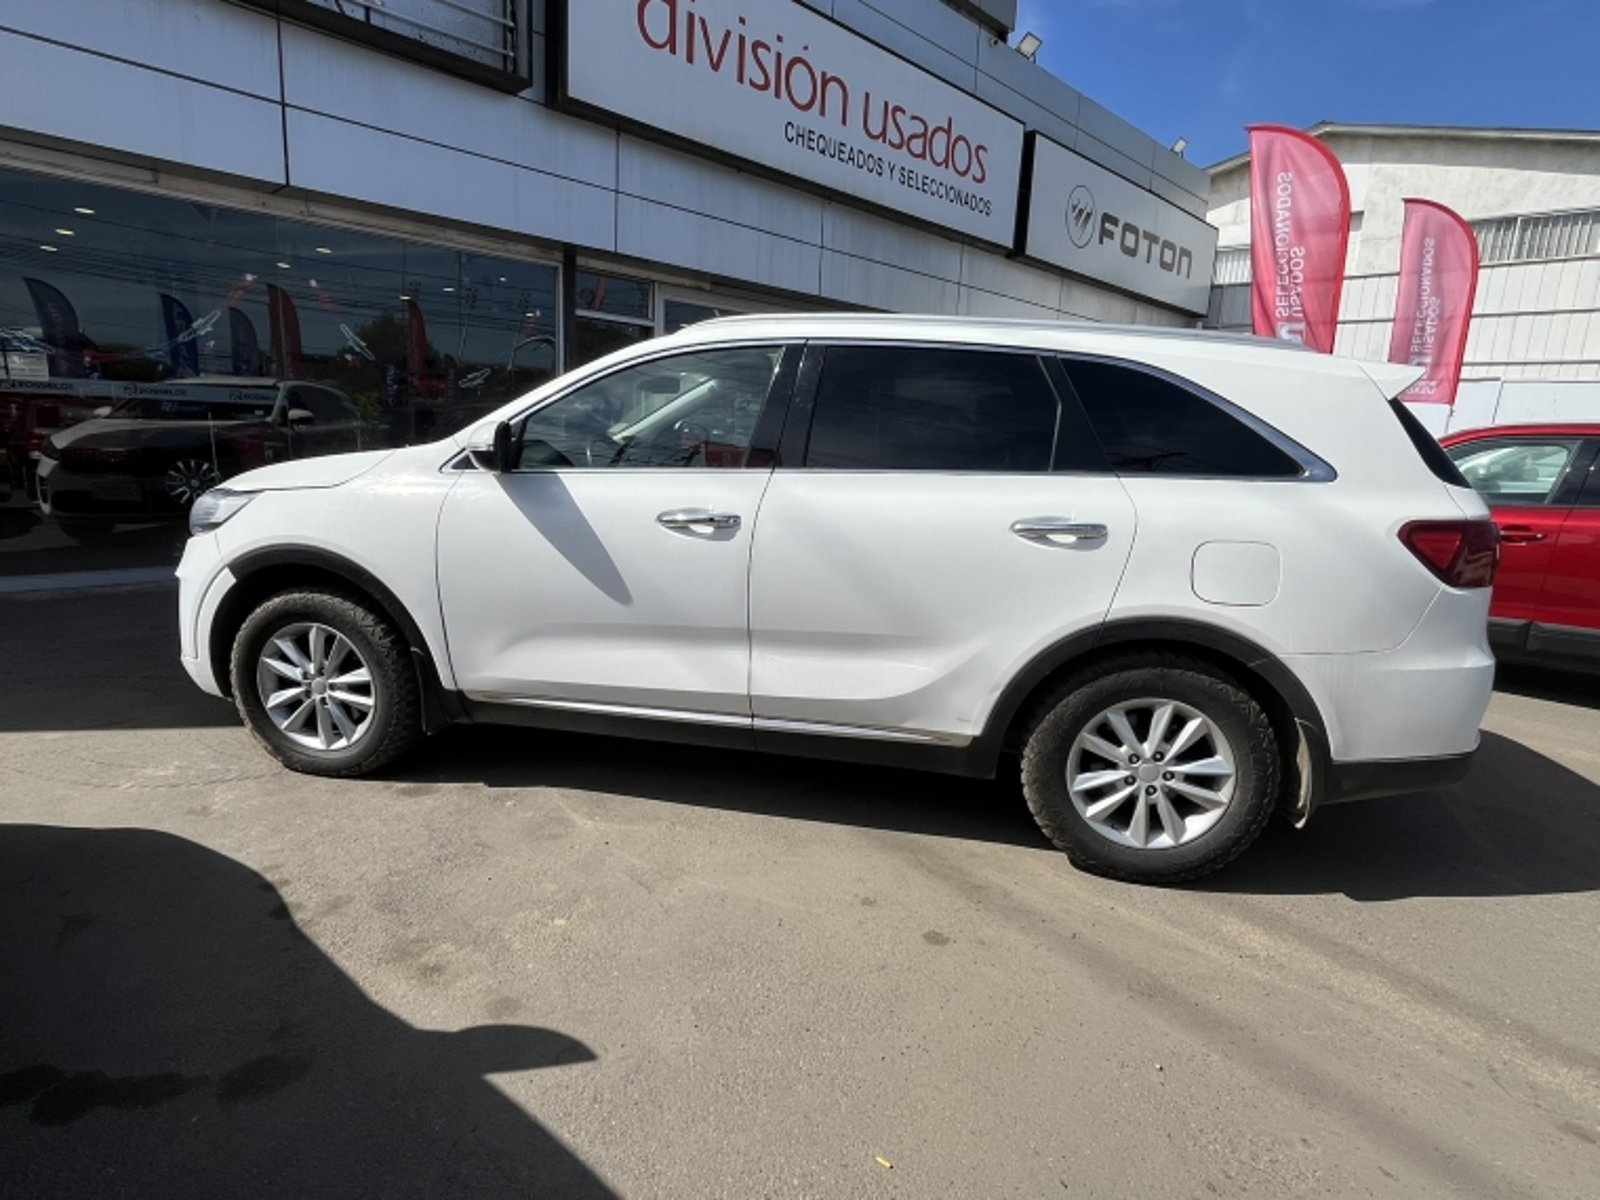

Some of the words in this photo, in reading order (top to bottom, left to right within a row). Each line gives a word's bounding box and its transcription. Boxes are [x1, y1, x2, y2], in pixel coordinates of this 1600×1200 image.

[637, 0, 849, 127] división
[862, 91, 988, 184] usados
[784, 121, 884, 178] CHEQUEADOS
[887, 161, 897, 181] Y
[899, 166, 993, 217] SELECCIONADOS
[1098, 211, 1193, 280] FOTON
